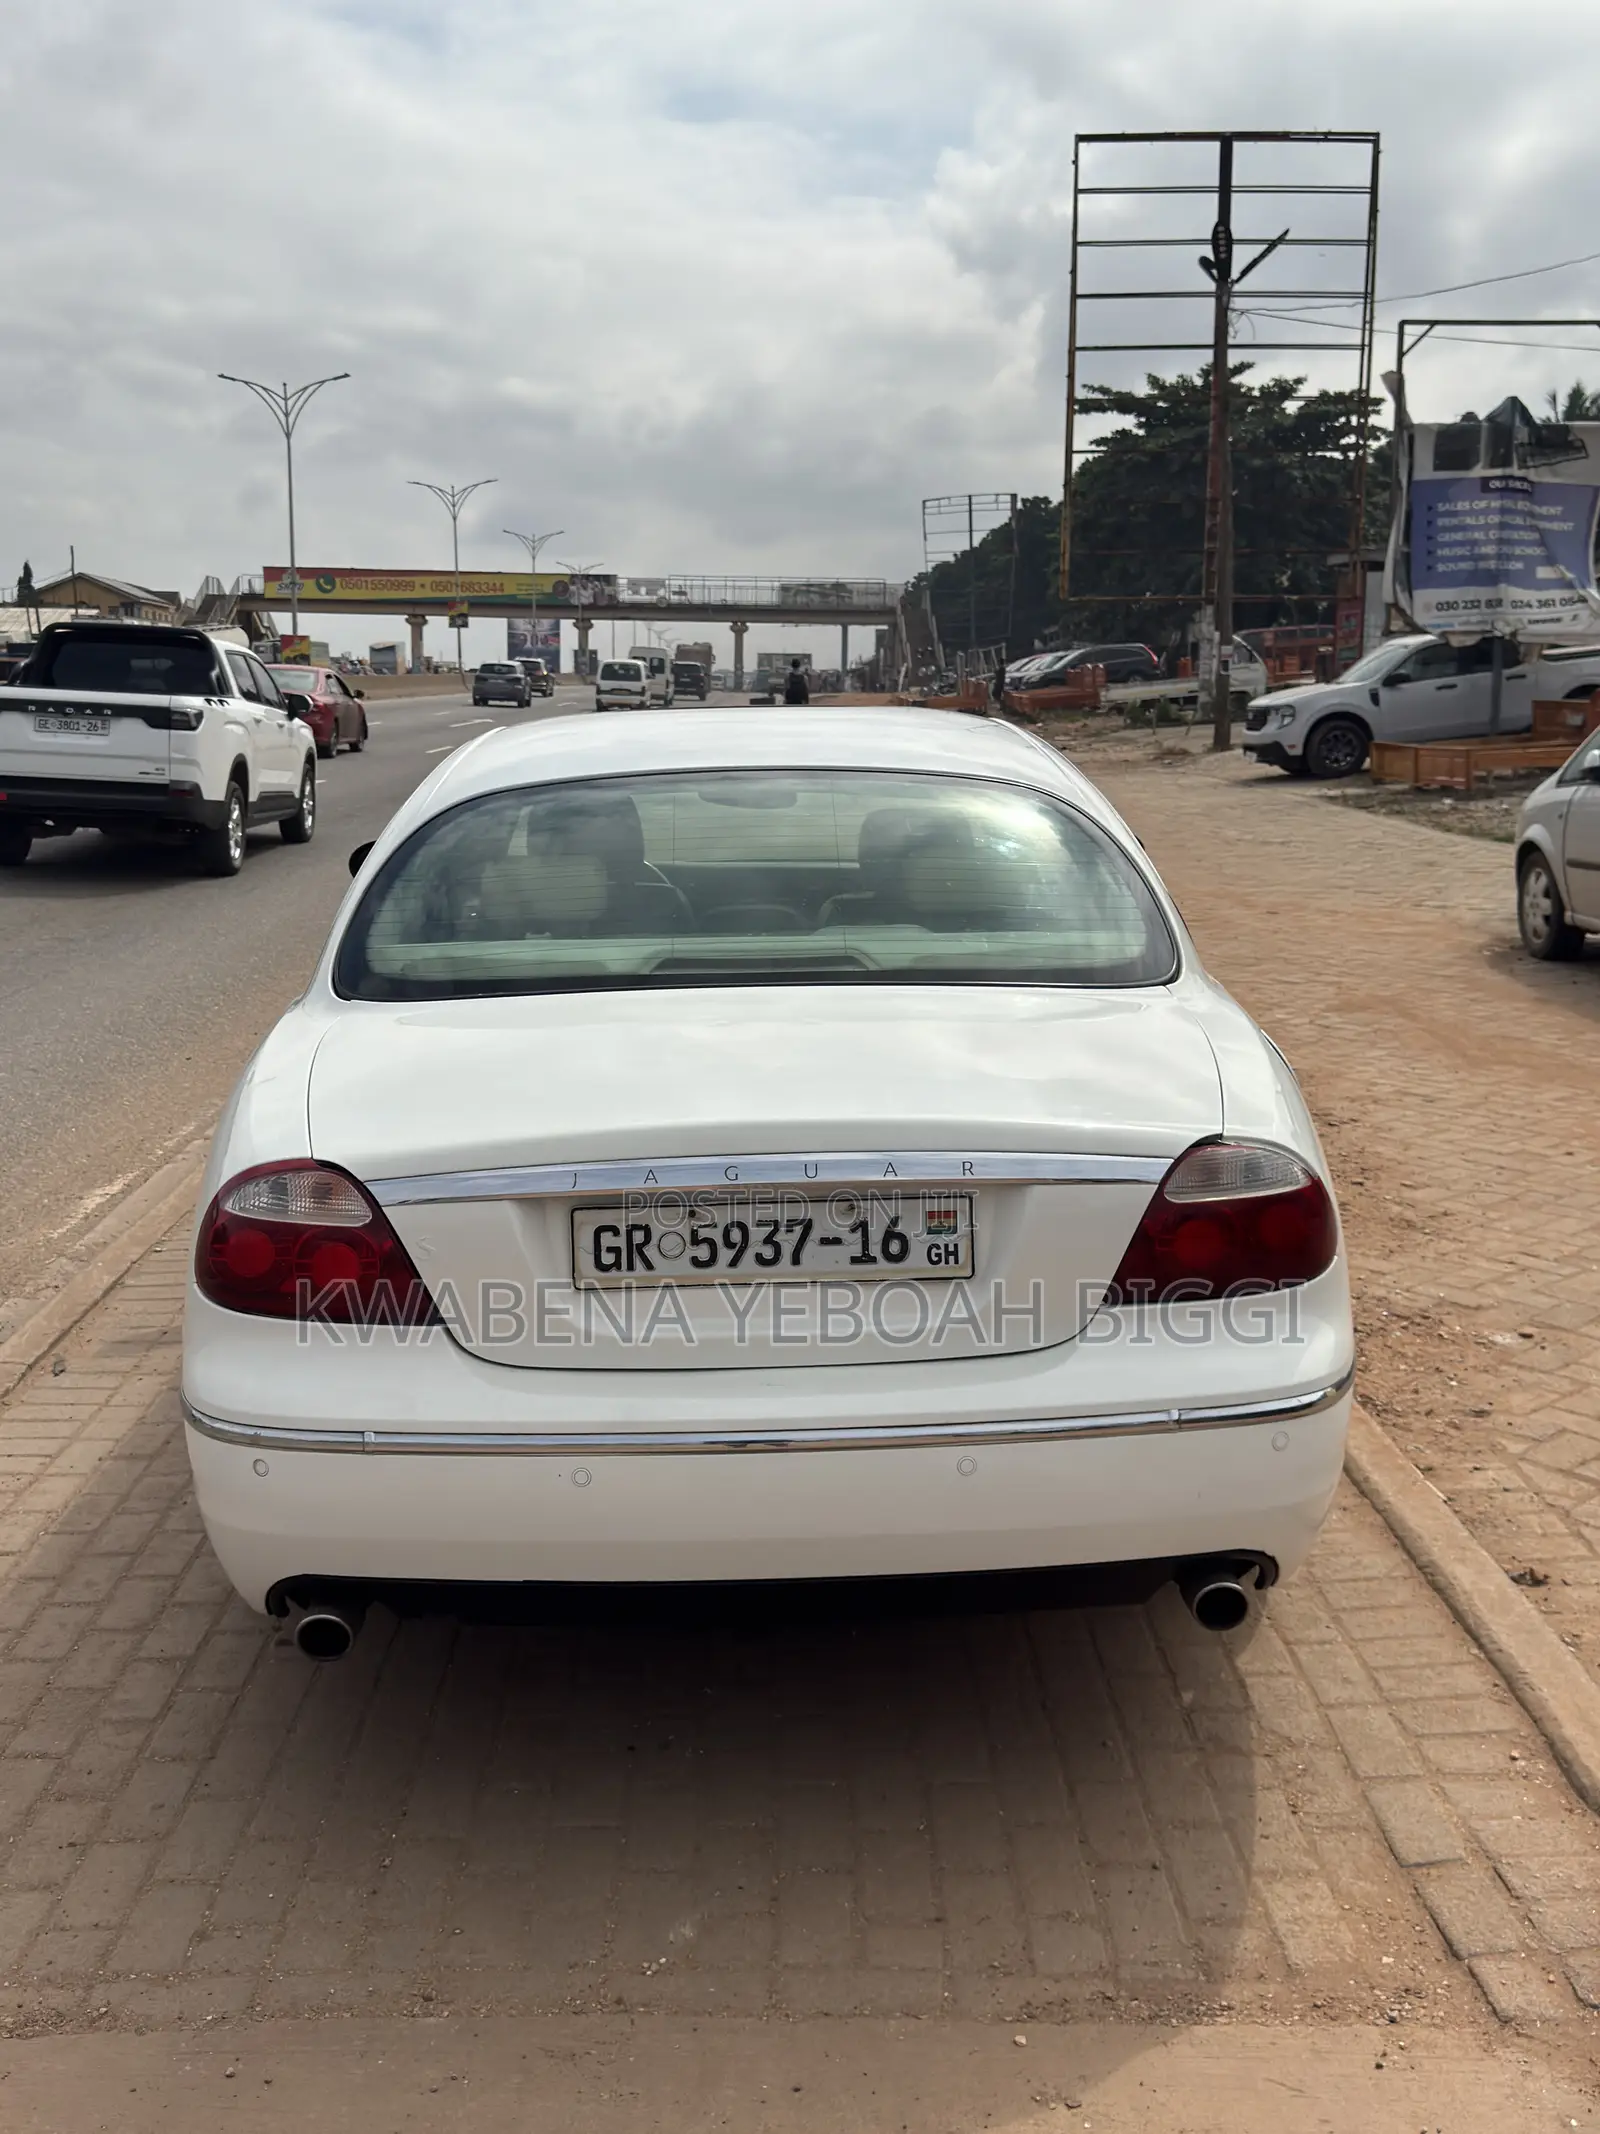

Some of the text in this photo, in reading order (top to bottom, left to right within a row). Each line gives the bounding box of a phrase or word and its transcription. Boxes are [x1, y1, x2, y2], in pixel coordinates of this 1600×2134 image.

[340, 577, 415, 591] 0501550999
[1435, 600, 1459, 612] 030
[28, 705, 112, 715] RADAR
[571, 1160, 975, 1189] JAGUAR
[592, 1214, 911, 1273] GR 5937-16
[926, 1243, 961, 1266] GH
